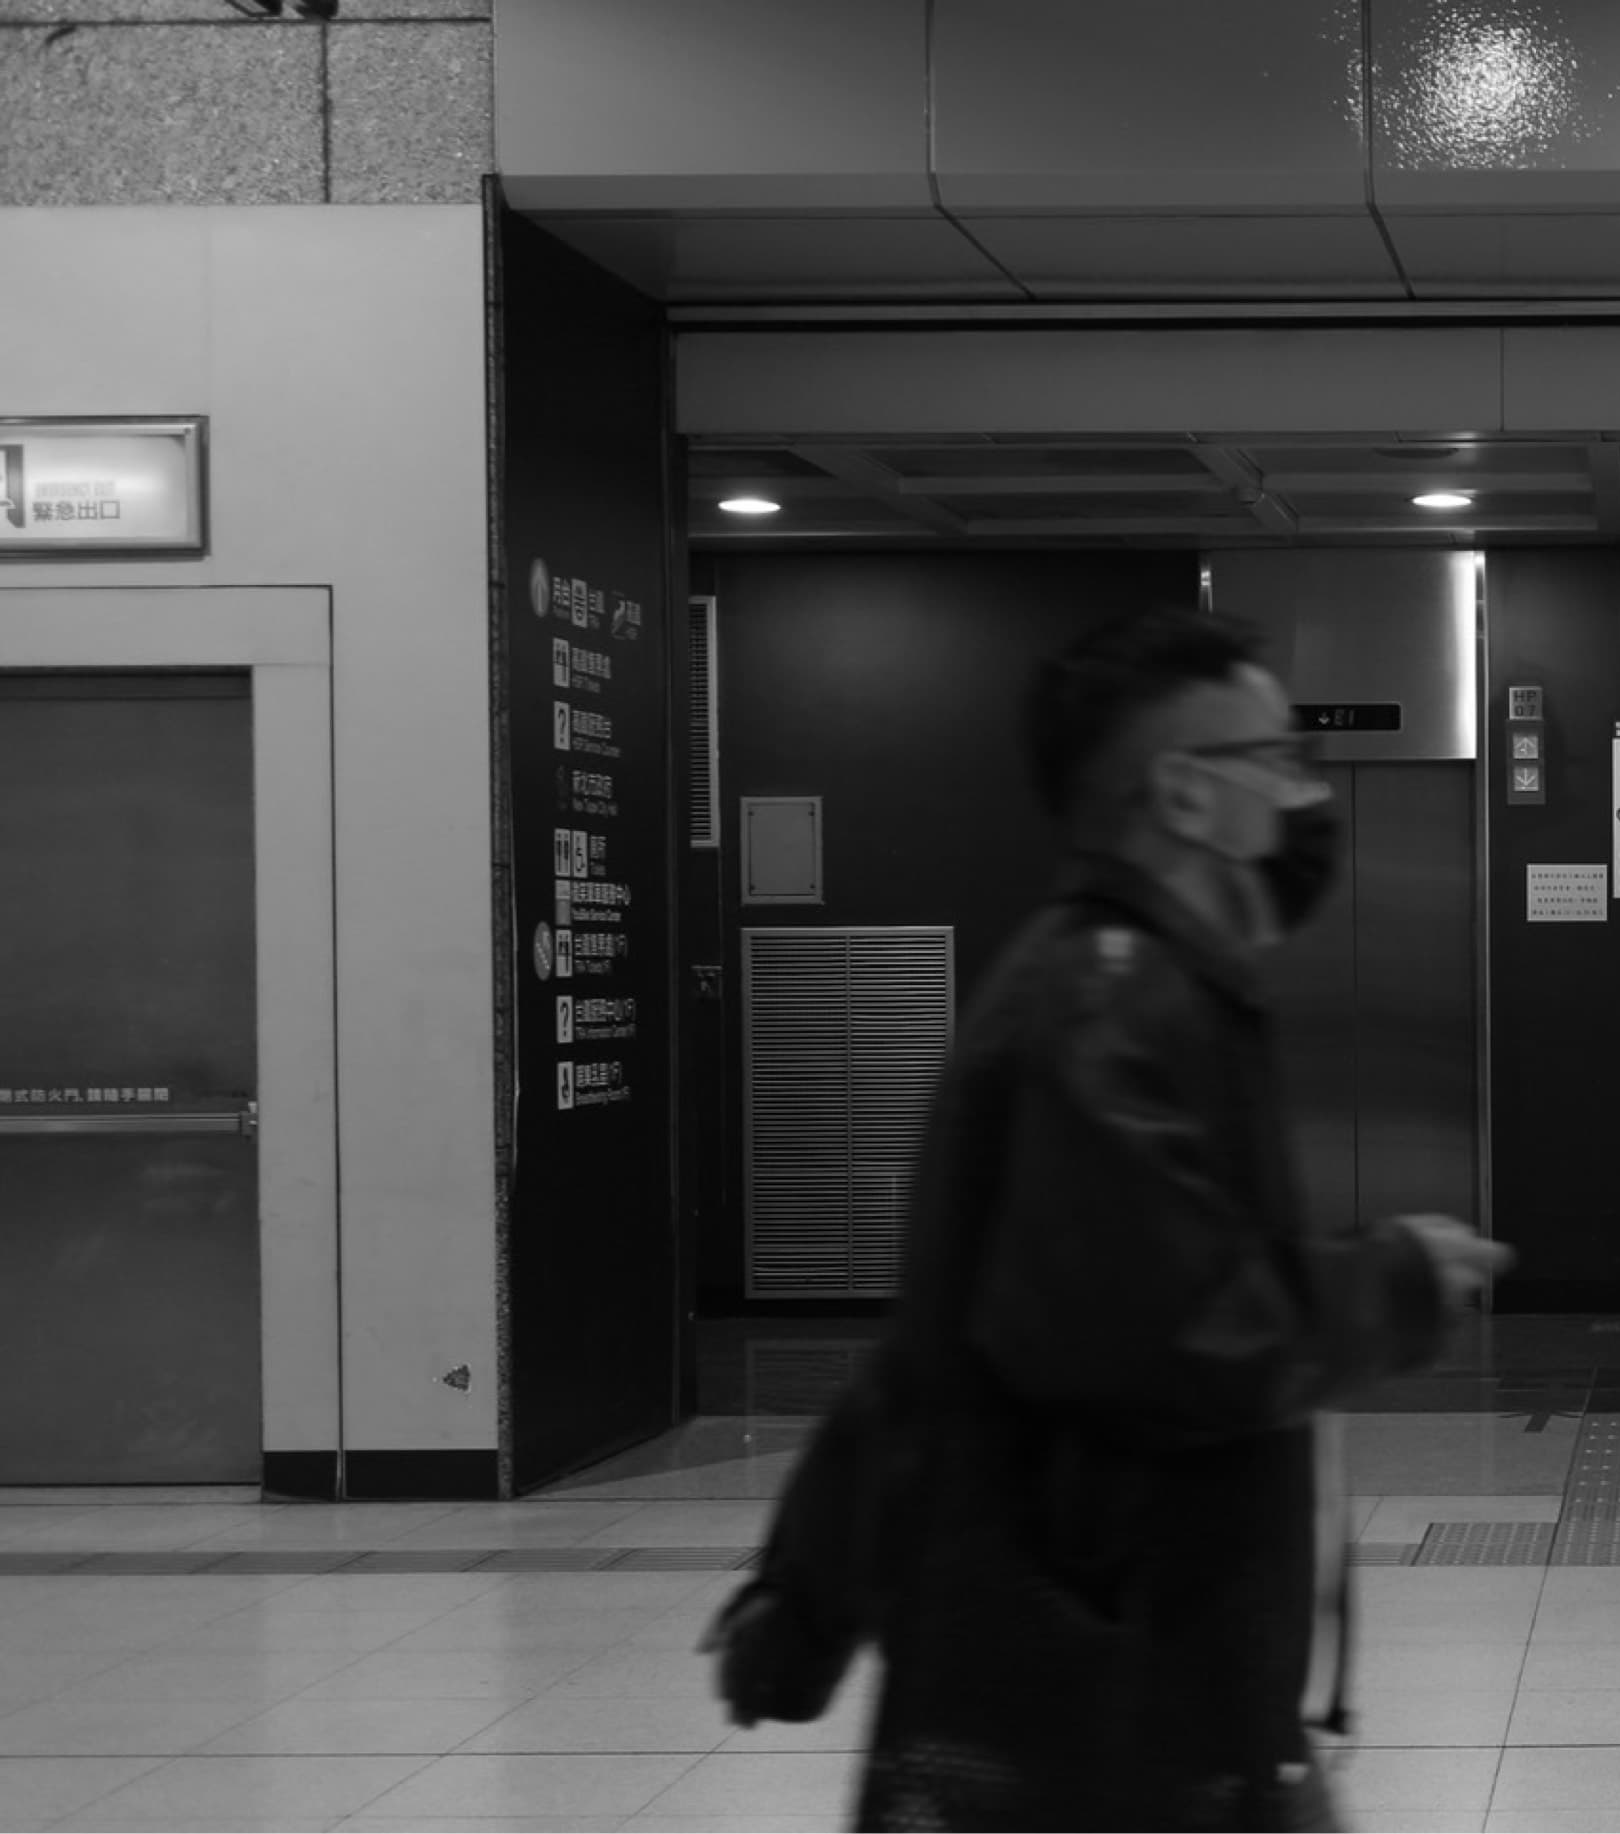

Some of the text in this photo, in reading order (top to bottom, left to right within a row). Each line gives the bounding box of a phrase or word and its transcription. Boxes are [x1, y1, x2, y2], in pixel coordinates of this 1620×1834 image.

[33, 500, 121, 522] 緊急出口
[1514, 690, 1537, 702] HP
